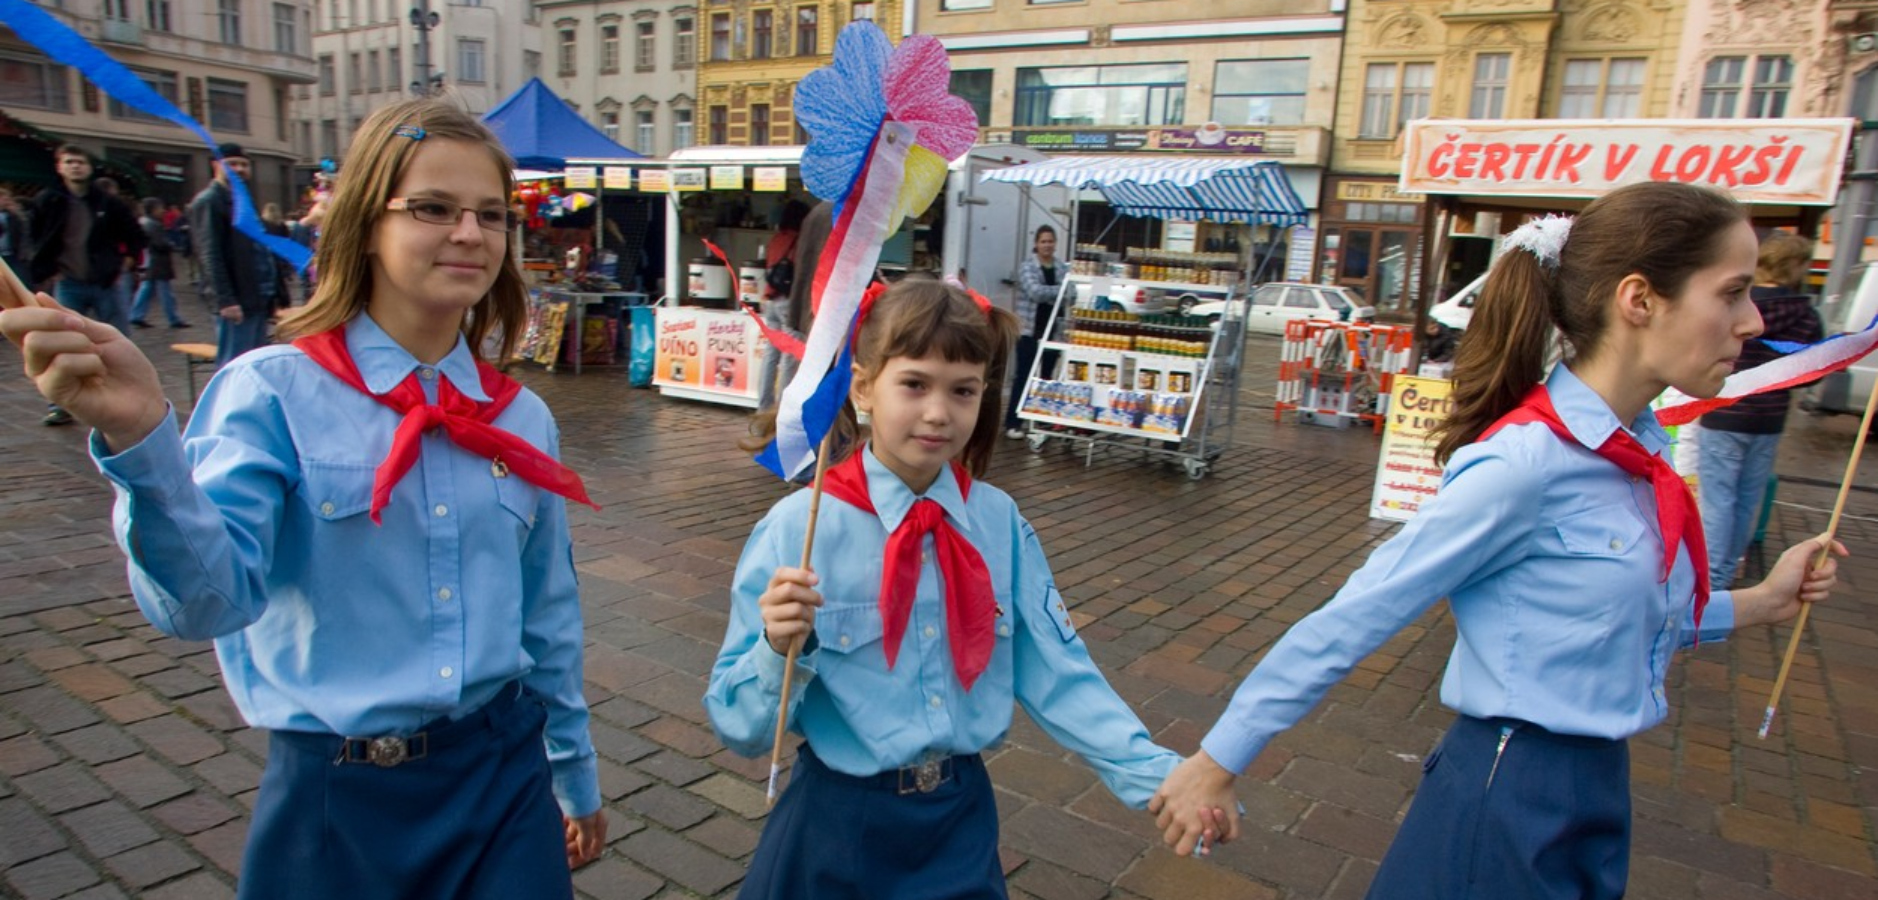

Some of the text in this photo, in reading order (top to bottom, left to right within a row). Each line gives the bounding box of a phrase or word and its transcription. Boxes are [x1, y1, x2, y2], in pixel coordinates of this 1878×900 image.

[1226, 133, 1263, 147] CAFÉ
[1427, 133, 1805, 187] ČERTÍK V LOKŠI
[660, 335, 699, 357] VÍNO
[708, 336, 745, 355] PUNČ
[1401, 382, 1453, 414] Čert
